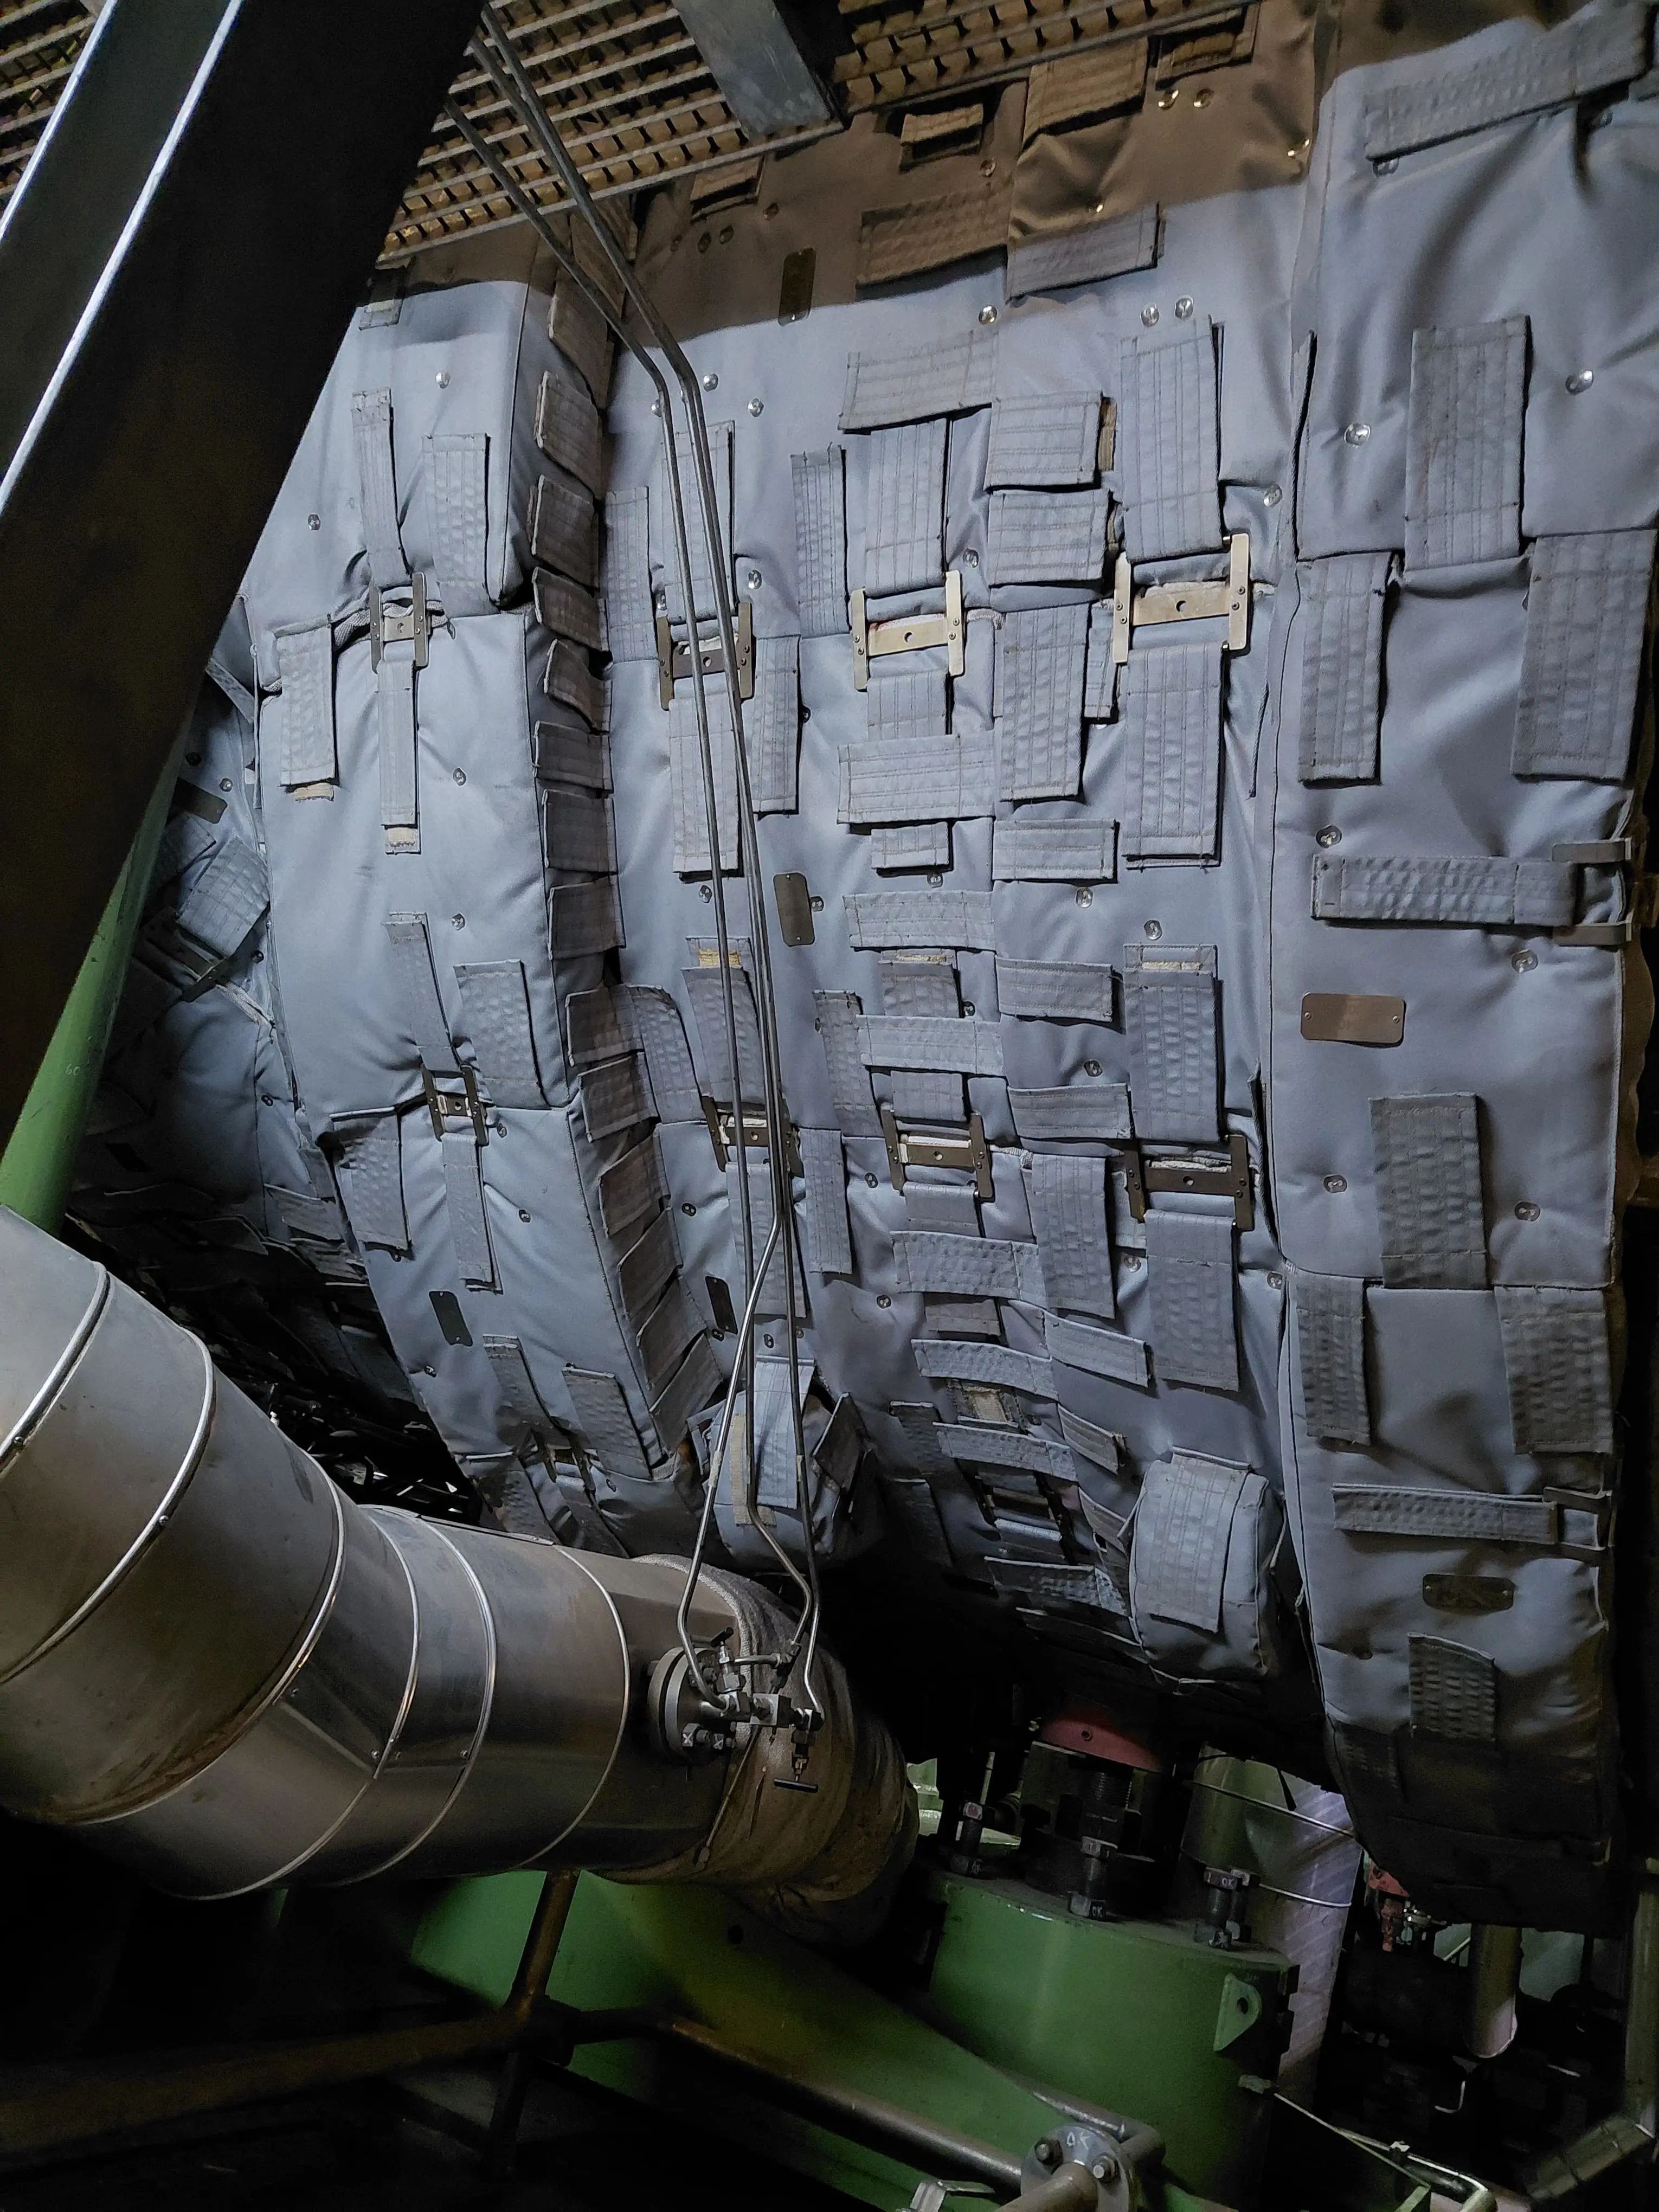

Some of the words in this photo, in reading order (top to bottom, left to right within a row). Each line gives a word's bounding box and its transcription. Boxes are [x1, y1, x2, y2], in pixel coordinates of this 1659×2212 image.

[1221, 1877, 1235, 1889] OK
[1091, 1905, 1103, 1918] OK
[1066, 2131, 1090, 2150] OK
